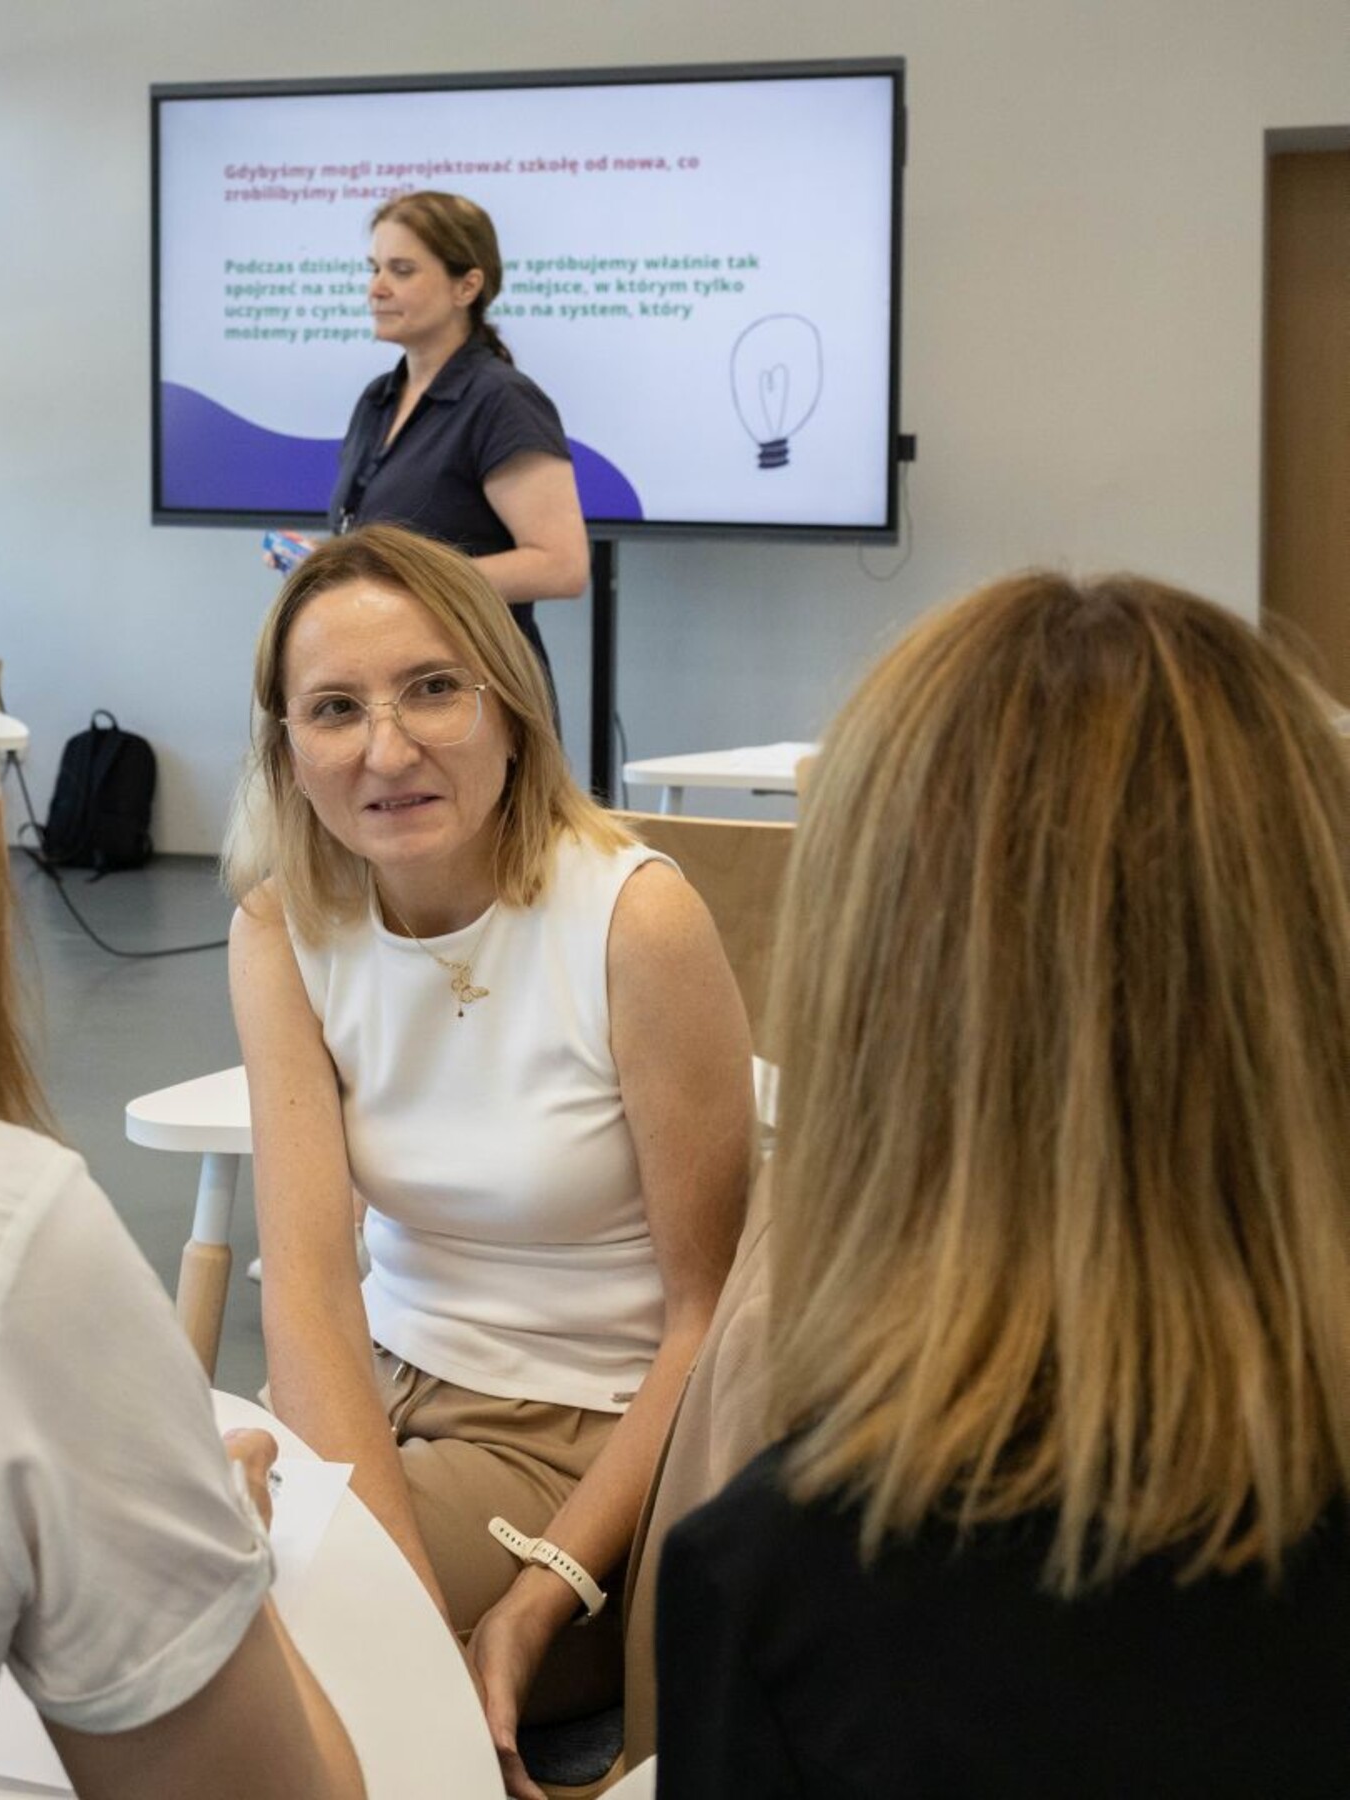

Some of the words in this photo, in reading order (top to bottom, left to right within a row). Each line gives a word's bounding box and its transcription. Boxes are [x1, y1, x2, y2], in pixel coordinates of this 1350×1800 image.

[225, 163, 315, 181] Gdybyśmy
[321, 162, 371, 180] mogli
[376, 160, 512, 179] zaprojektować
[519, 157, 579, 174] szkołę
[585, 156, 608, 171] od
[613, 157, 672, 171] nowa,
[677, 157, 700, 169] co
[225, 186, 337, 203] zrobilibyśmy
[225, 259, 293, 274] Podczas
[525, 255, 637, 275] spróbujemy
[644, 255, 721, 270] właśnie
[728, 254, 759, 270] tak
[225, 281, 296, 300] spojrzeć
[301, 284, 324, 295] na
[329, 281, 368, 295] szko
[511, 279, 590, 298] miejsce,
[594, 281, 610, 293] w
[616, 278, 688, 297] którym
[694, 278, 745, 296] tylko
[225, 305, 291, 321] uczymy
[296, 306, 306, 317] o
[530, 304, 554, 316] na
[559, 303, 631, 320] system,
[639, 301, 692, 320] który
[225, 326, 297, 343] możemy
